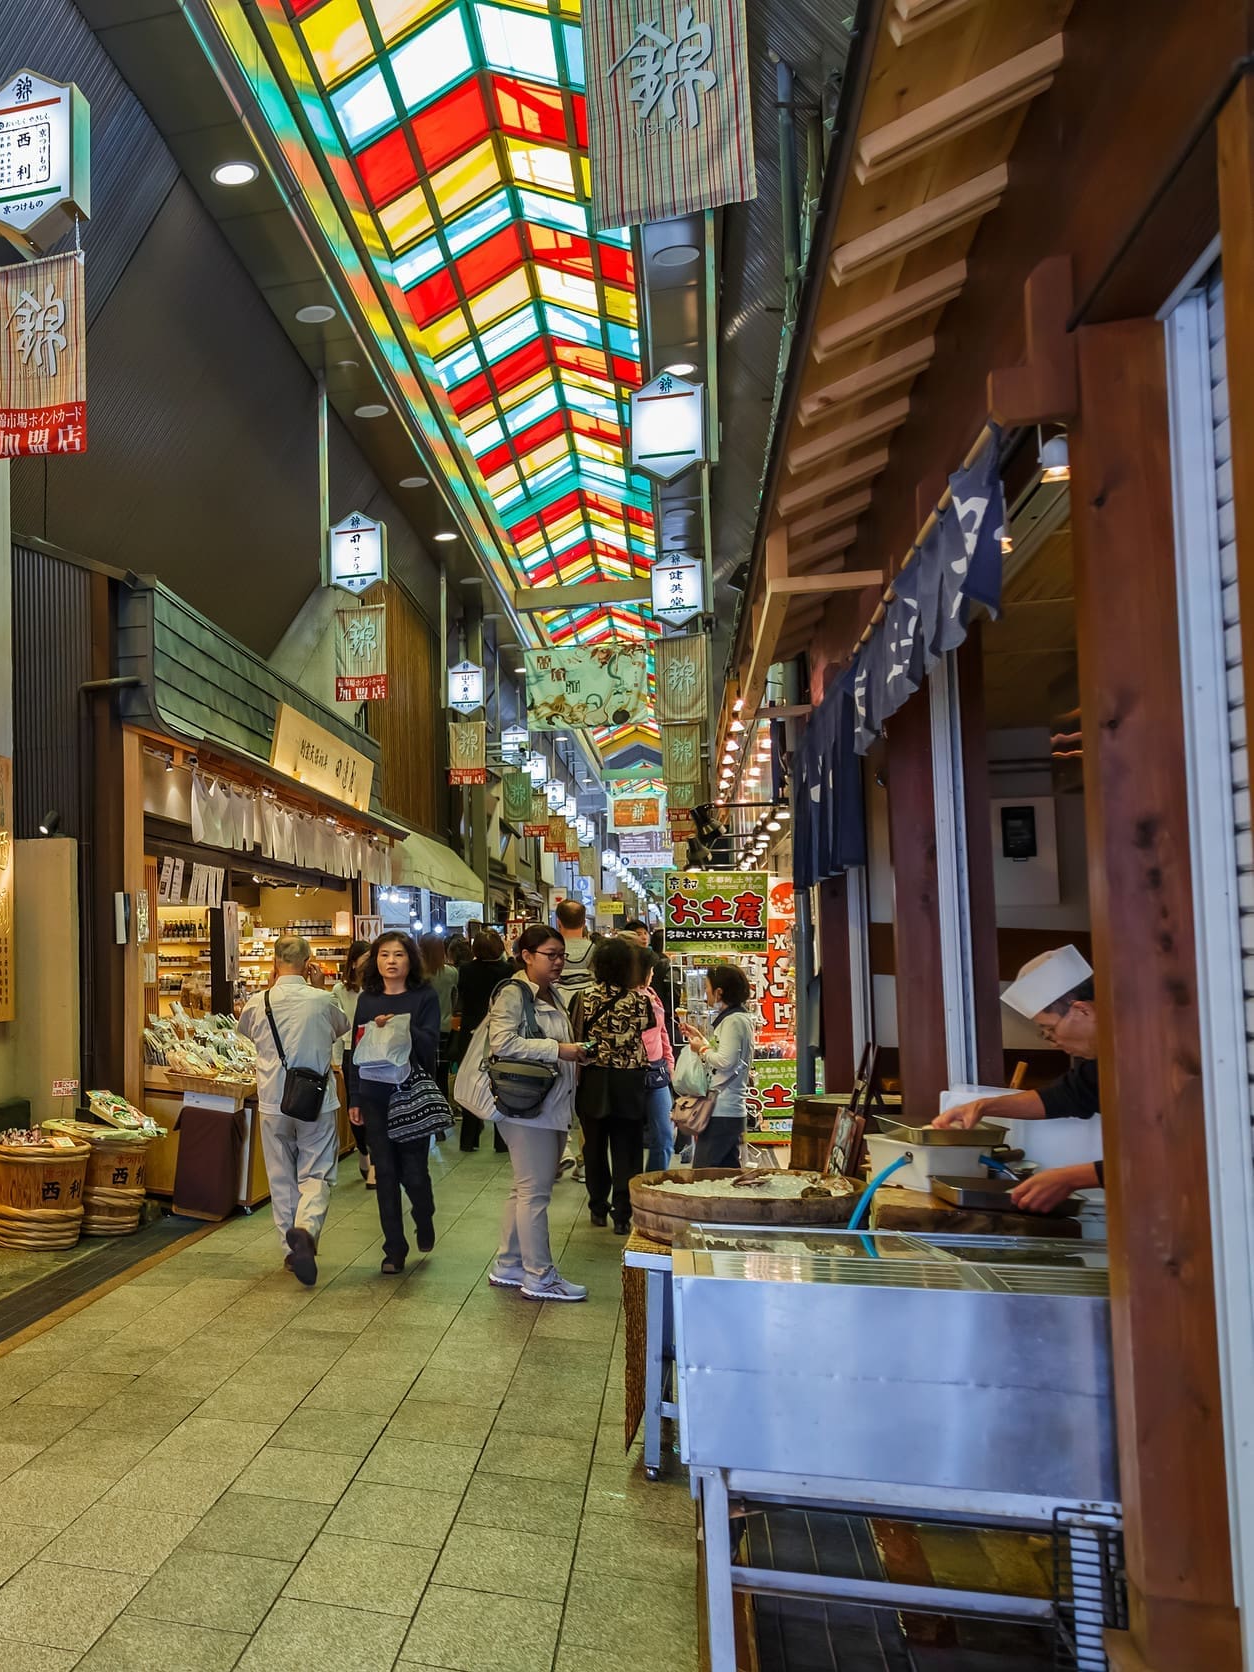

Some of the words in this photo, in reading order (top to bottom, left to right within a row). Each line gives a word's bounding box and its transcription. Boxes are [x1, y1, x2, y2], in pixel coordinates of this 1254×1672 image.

[607, 7, 717, 129] 錦
[13, 76, 33, 102] 錦
[17, 132, 32, 181] 西利
[3, 200, 44, 215] 京つけもの
[5, 282, 67, 377] 錦
[343, 615, 377, 663] 錦
[338, 685, 386, 701] 加盟店
[663, 655, 697, 697] 錦
[458, 728, 479, 759] 錦
[668, 876, 699, 890] 京都
[667, 890, 765, 928] お土産
[42, 1178, 82, 1201] 西利
